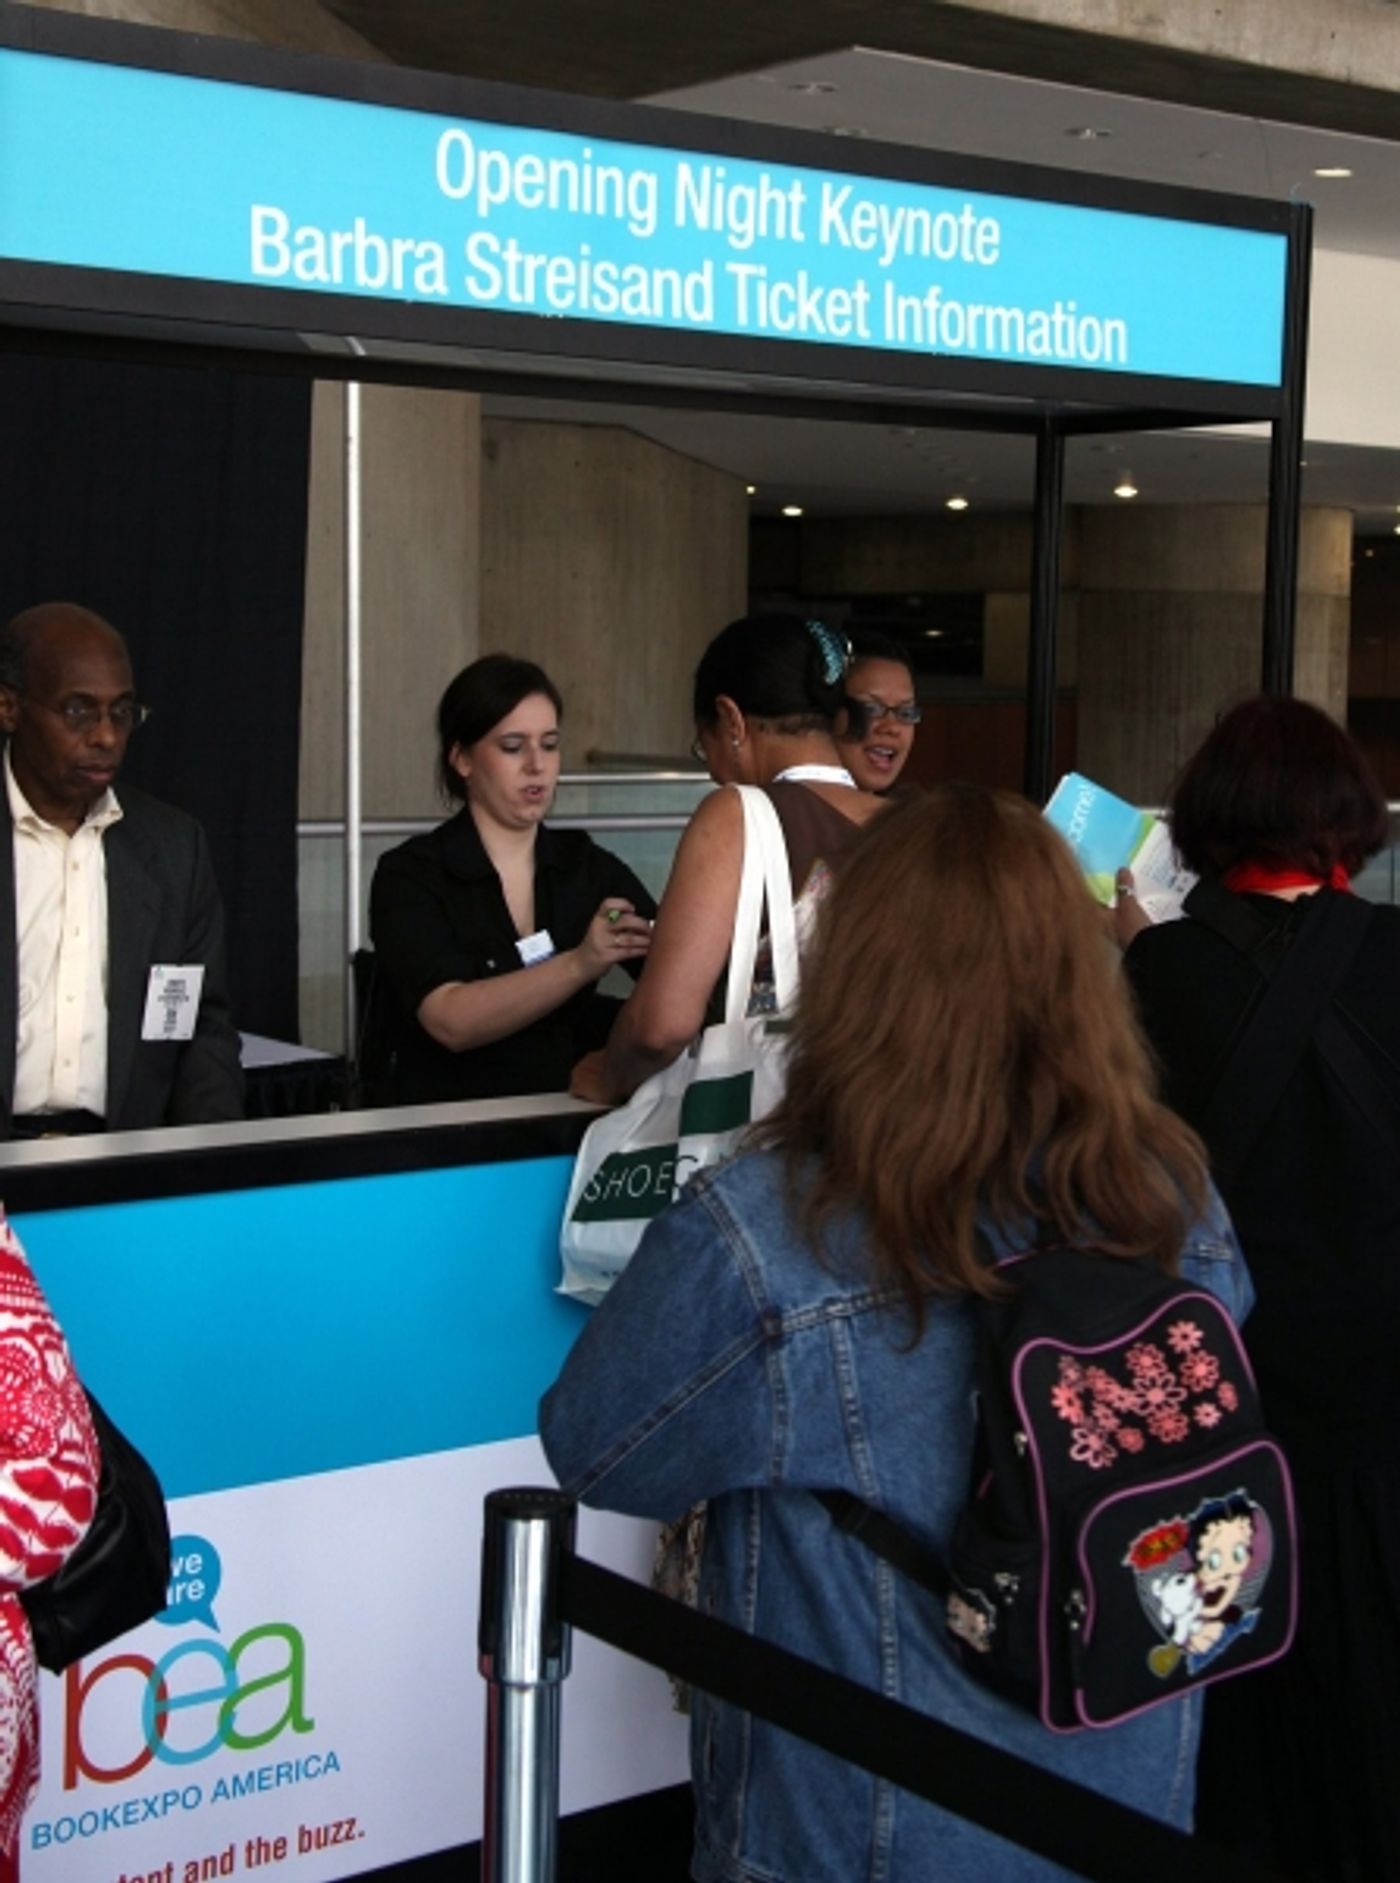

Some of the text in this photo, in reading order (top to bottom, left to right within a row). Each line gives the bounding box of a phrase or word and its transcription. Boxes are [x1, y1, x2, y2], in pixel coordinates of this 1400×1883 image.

[436, 128, 999, 266] Opening Night Keynote
[251, 204, 1128, 363] Barbra Streisand Ticket Information
[63, 1622, 315, 1791] bea
[31, 1751, 341, 1850] BOOKEXPO AMERICA
[184, 1843, 235, 1883] and
[244, 1836, 288, 1869] the
[297, 1817, 366, 1855] buzz.
